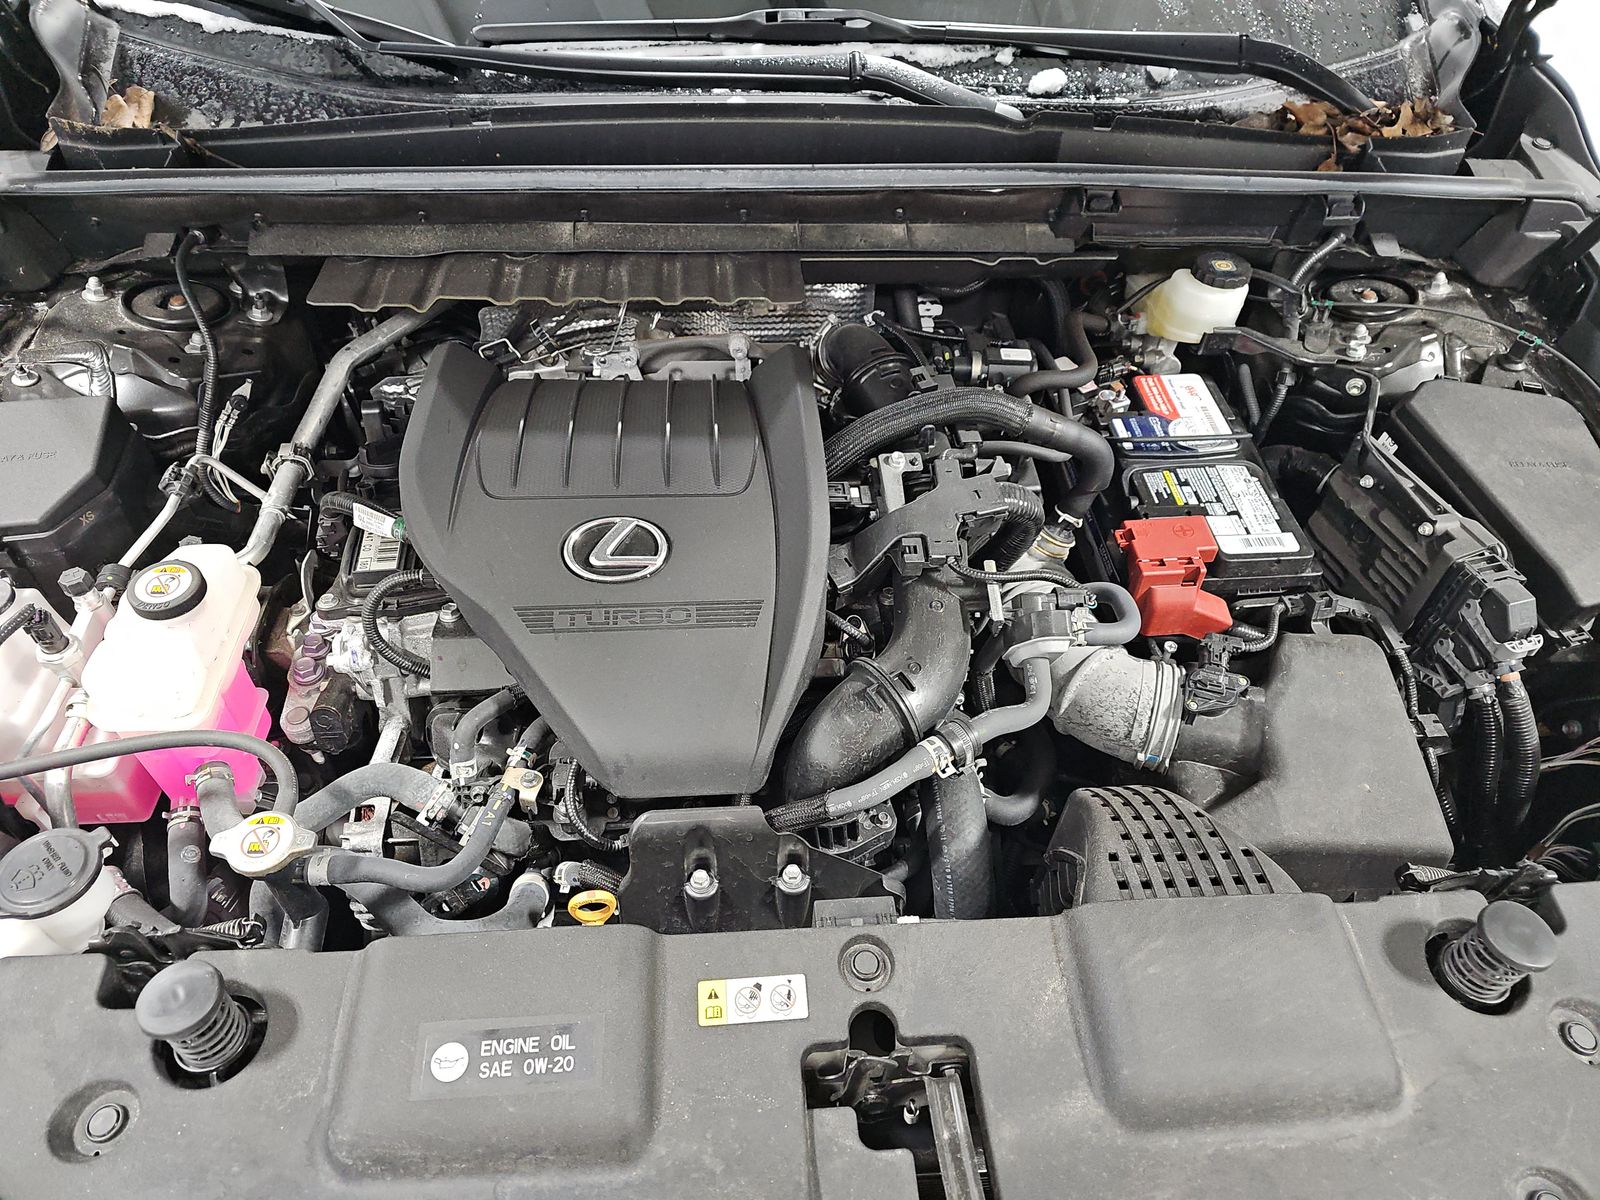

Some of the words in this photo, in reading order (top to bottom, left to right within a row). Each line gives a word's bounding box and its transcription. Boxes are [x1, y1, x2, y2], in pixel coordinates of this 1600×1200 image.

[136, 601, 170, 610] DENSO
[558, 607, 692, 627] TURBO
[480, 1036, 540, 1056] ENGINE
[550, 1034, 576, 1050] OIL
[478, 1060, 513, 1079] SAE
[523, 1056, 575, 1075] 0W-20
